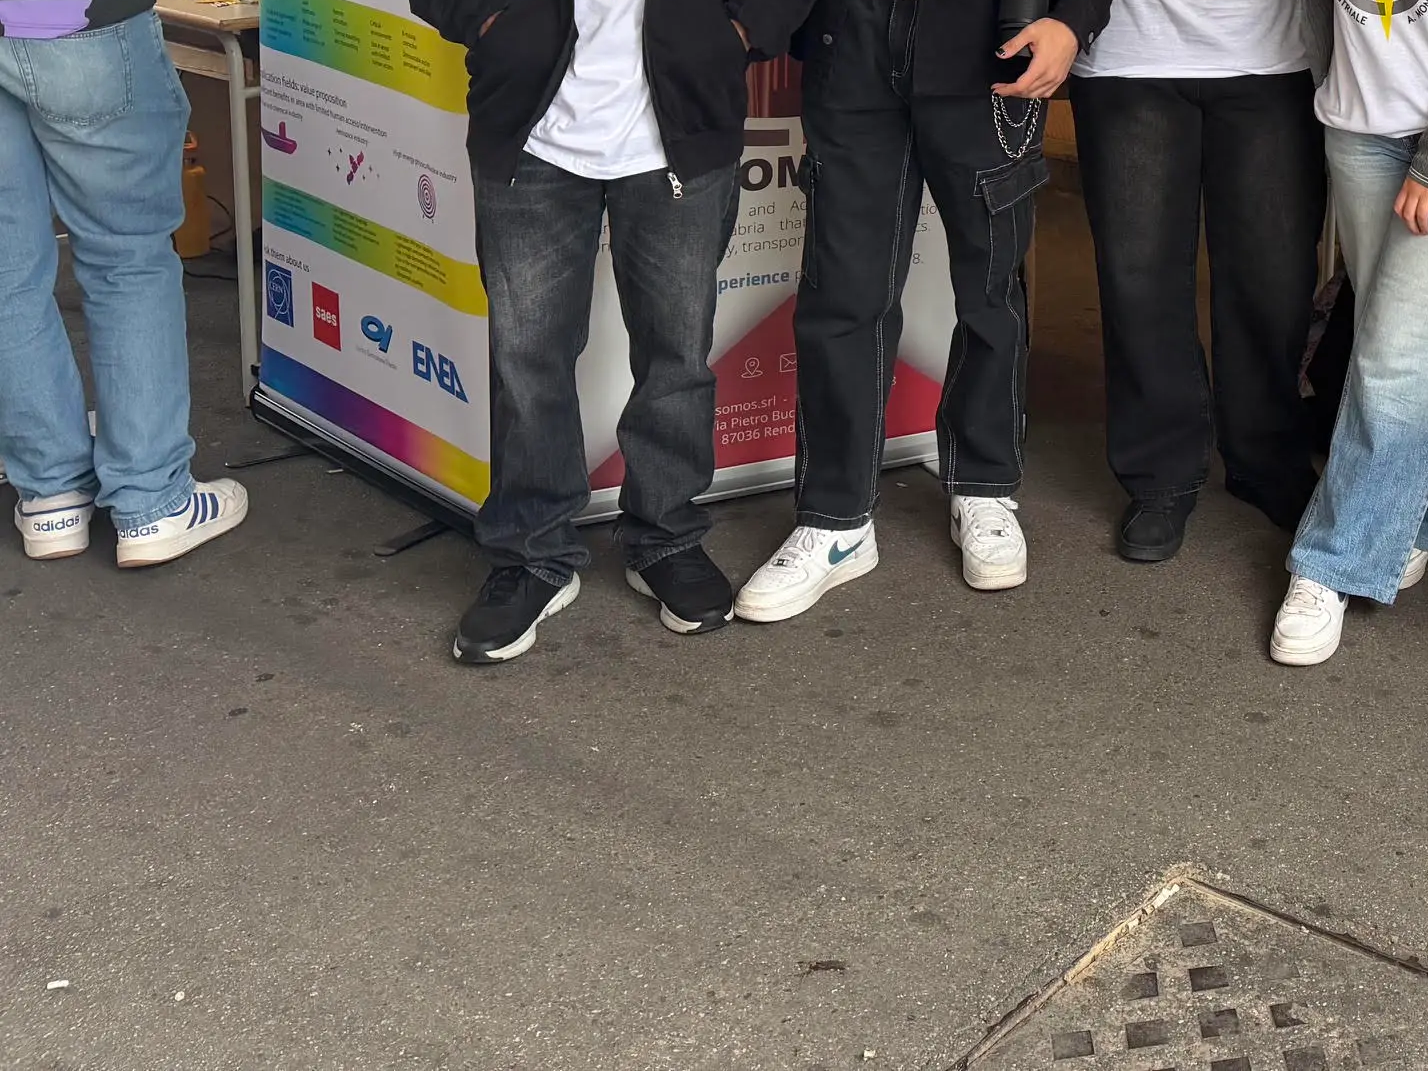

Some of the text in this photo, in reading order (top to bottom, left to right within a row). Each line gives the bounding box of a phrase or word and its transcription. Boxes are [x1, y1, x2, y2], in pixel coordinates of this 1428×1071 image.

[300, 82, 316, 97] value
[749, 202, 776, 217] and
[315, 306, 337, 327] saes
[412, 340, 469, 404] ENEA
[715, 395, 776, 416] somos.srl
[731, 414, 768, 429] Pietro
[721, 428, 760, 445] 87036
[33, 513, 80, 532] adidas
